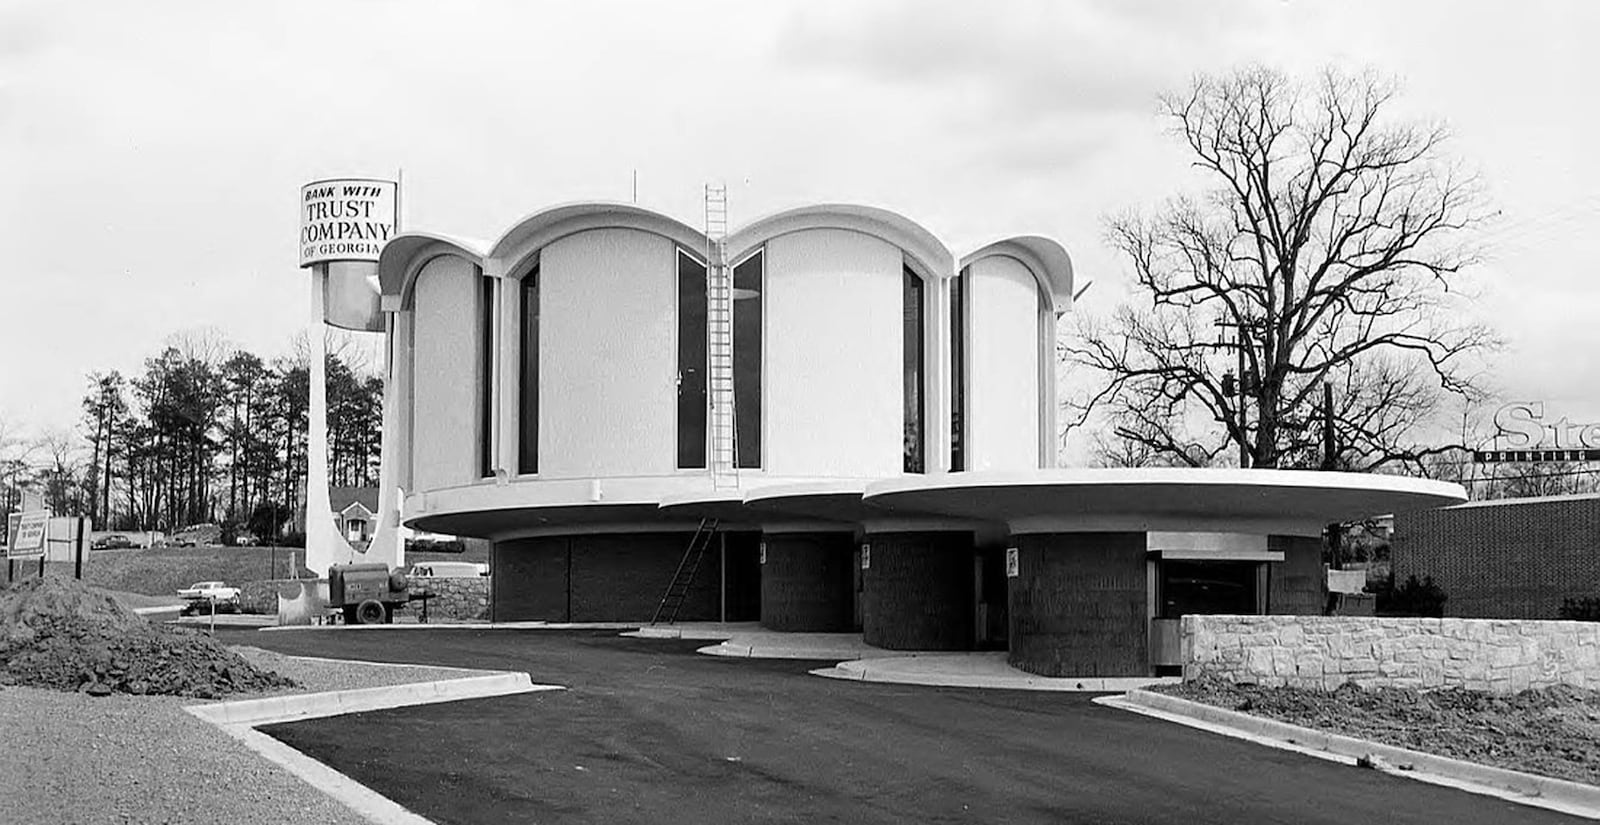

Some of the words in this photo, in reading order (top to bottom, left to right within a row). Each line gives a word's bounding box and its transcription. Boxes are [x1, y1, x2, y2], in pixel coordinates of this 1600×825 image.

[305, 187, 336, 201] BANK
[343, 186, 382, 197] WITH
[307, 200, 375, 221] TRUST
[302, 222, 392, 244] COMPANY
[304, 245, 316, 257] OF
[319, 243, 380, 255] GEORGIA
[1485, 451, 1586, 462] PRINTING
